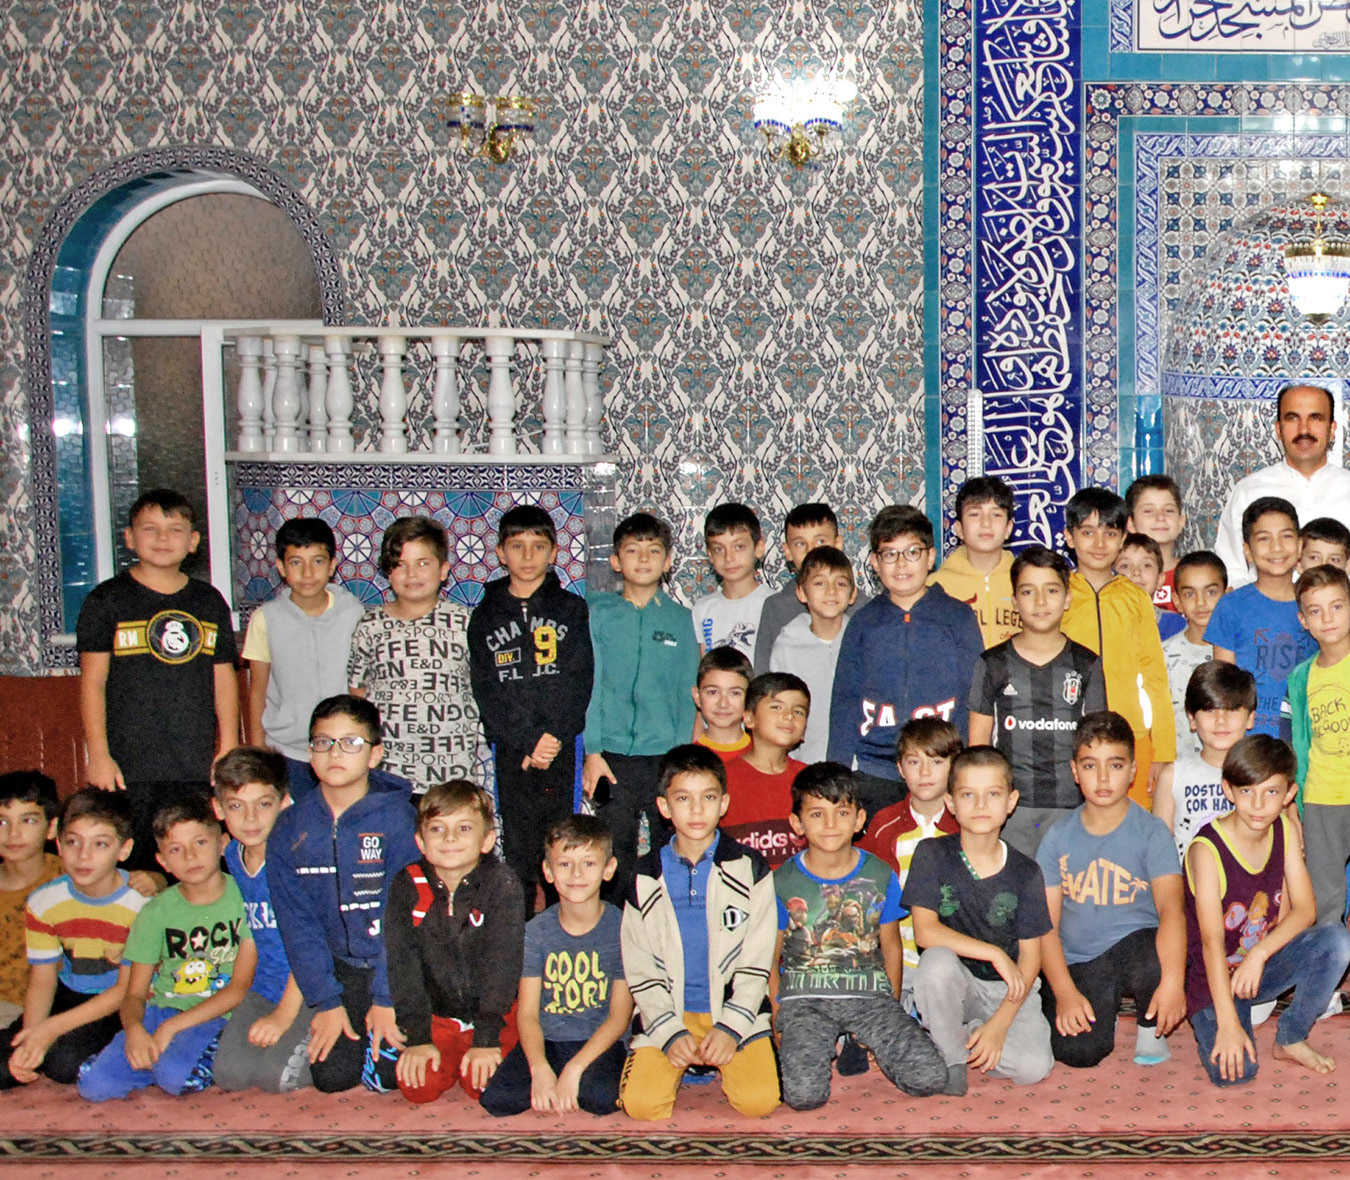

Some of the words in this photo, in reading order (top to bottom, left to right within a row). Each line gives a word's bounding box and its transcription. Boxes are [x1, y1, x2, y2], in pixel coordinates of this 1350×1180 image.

[118, 630, 138, 648] RM
[534, 625, 557, 666] 9
[1311, 697, 1347, 724] BACK
[1018, 718, 1078, 730] vodafone
[1186, 798, 1208, 814] ÇOK
[363, 836, 380, 849] GO
[736, 830, 788, 849] didas
[360, 848, 382, 861] WAY
[165, 917, 243, 960] ROCK
[545, 950, 605, 985] COOL
